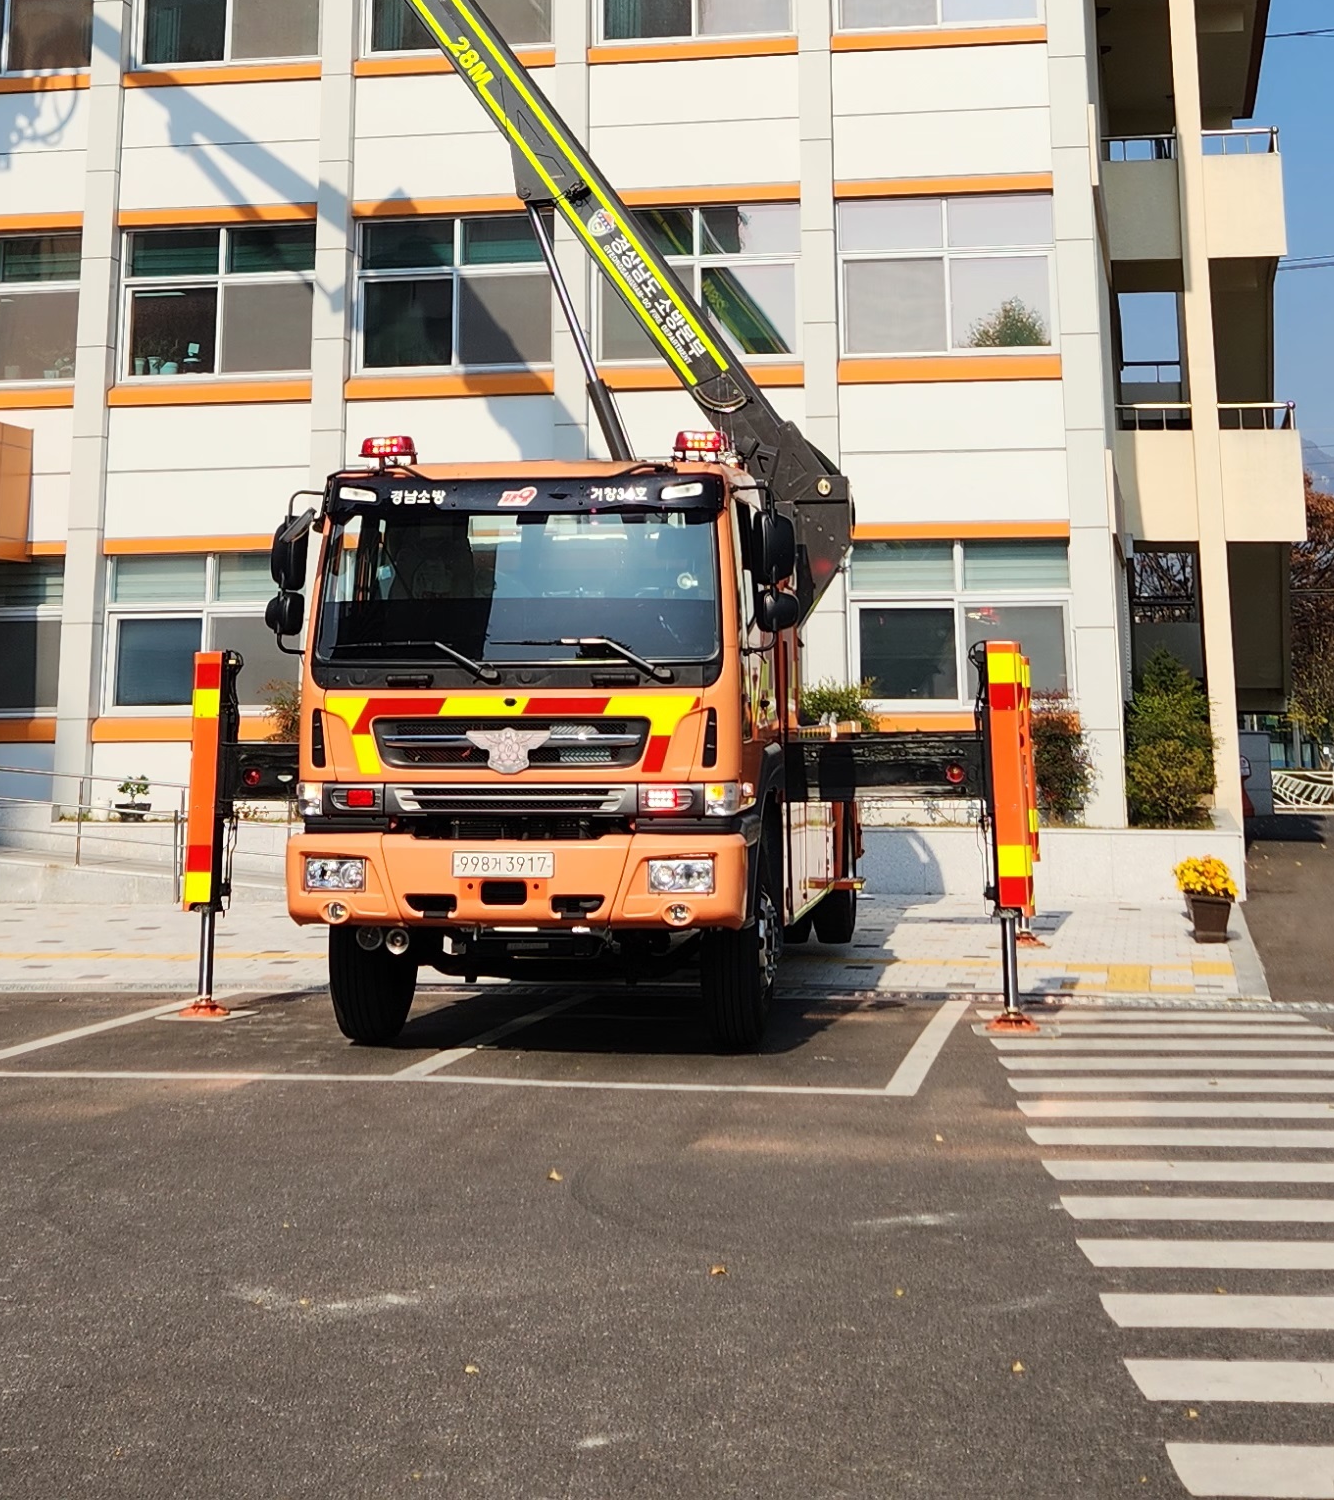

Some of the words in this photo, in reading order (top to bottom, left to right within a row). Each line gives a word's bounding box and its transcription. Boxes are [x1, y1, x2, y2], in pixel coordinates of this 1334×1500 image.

[449, 36, 494, 82] 28M
[611, 234, 661, 297] 경상남도
[654, 298, 706, 357] 소방본부
[649, 309, 663, 325] FIRE
[661, 324, 693, 364] DEPARTMENT
[390, 489, 446, 505] 경남소방
[460, 856, 501, 873] 998거
[506, 856, 547, 873] 3917
